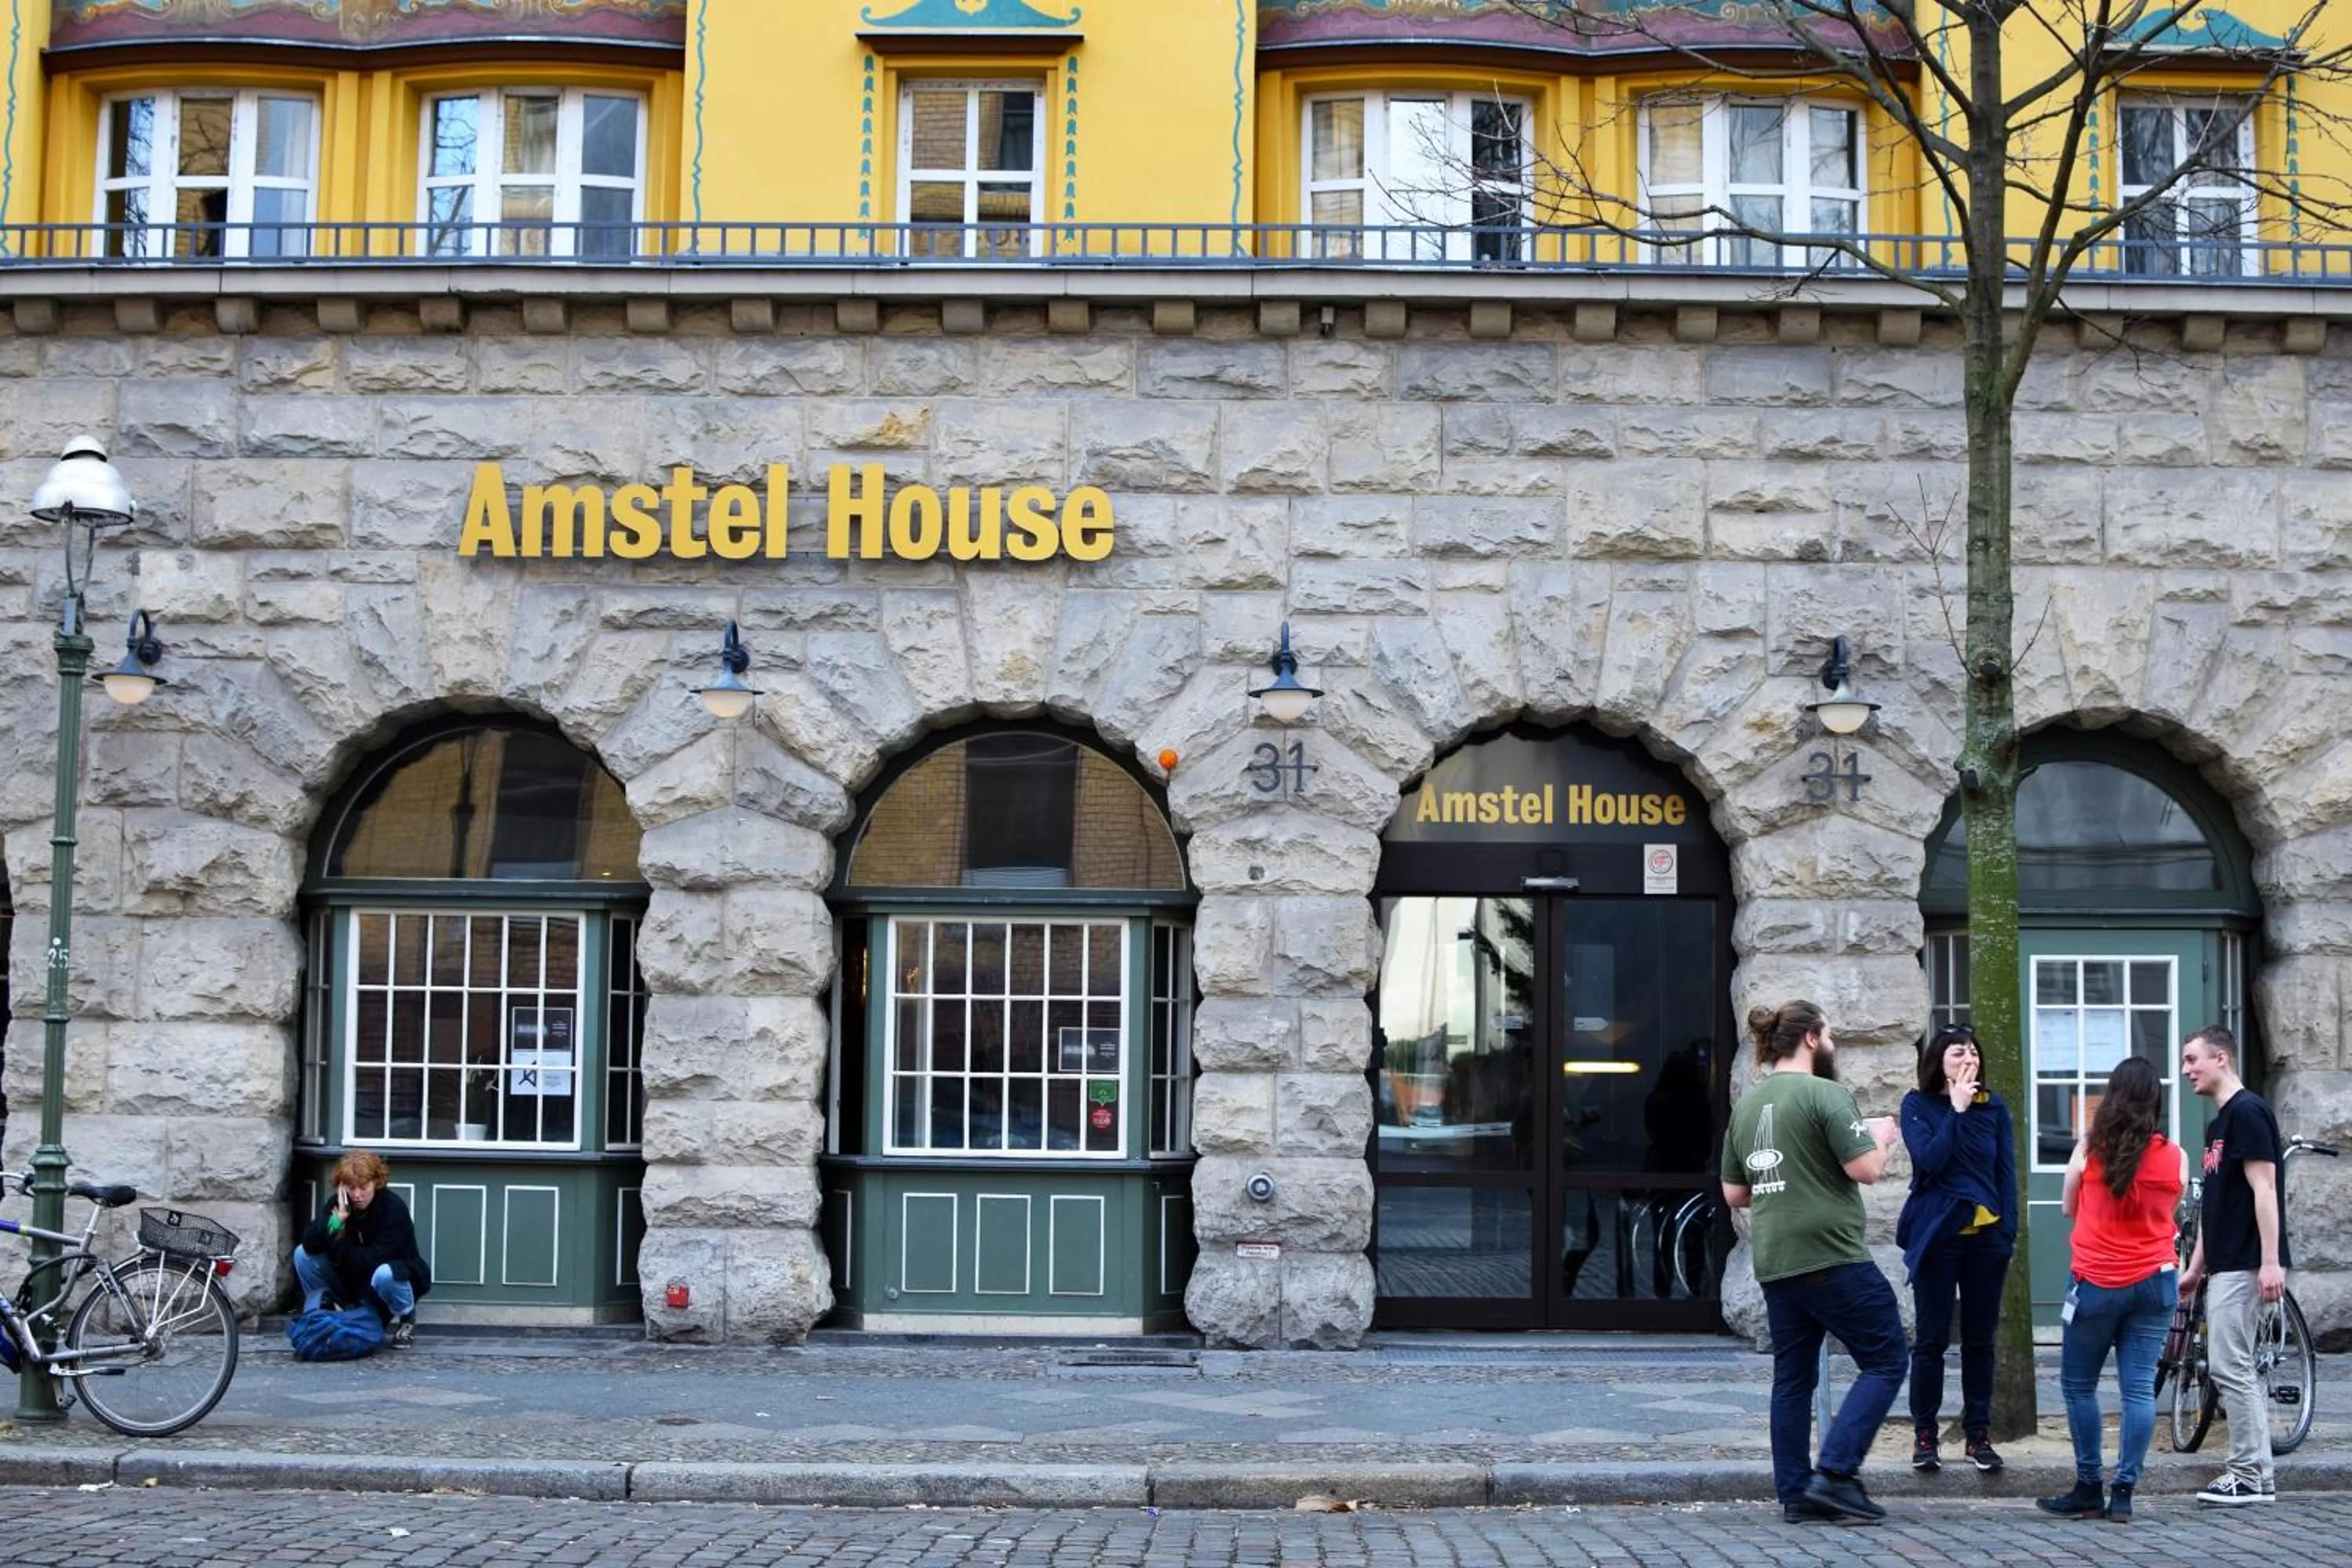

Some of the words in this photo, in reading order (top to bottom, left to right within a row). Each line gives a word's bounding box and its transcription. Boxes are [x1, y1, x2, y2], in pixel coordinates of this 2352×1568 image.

[459, 463, 789, 559] Amstel
[826, 463, 1115, 561] House
[1252, 742, 1305, 793] 31
[1806, 752, 1860, 801] 31
[1417, 783, 1553, 823] Amstel
[1569, 784, 1686, 825] House
[48, 948, 69, 970] 25
